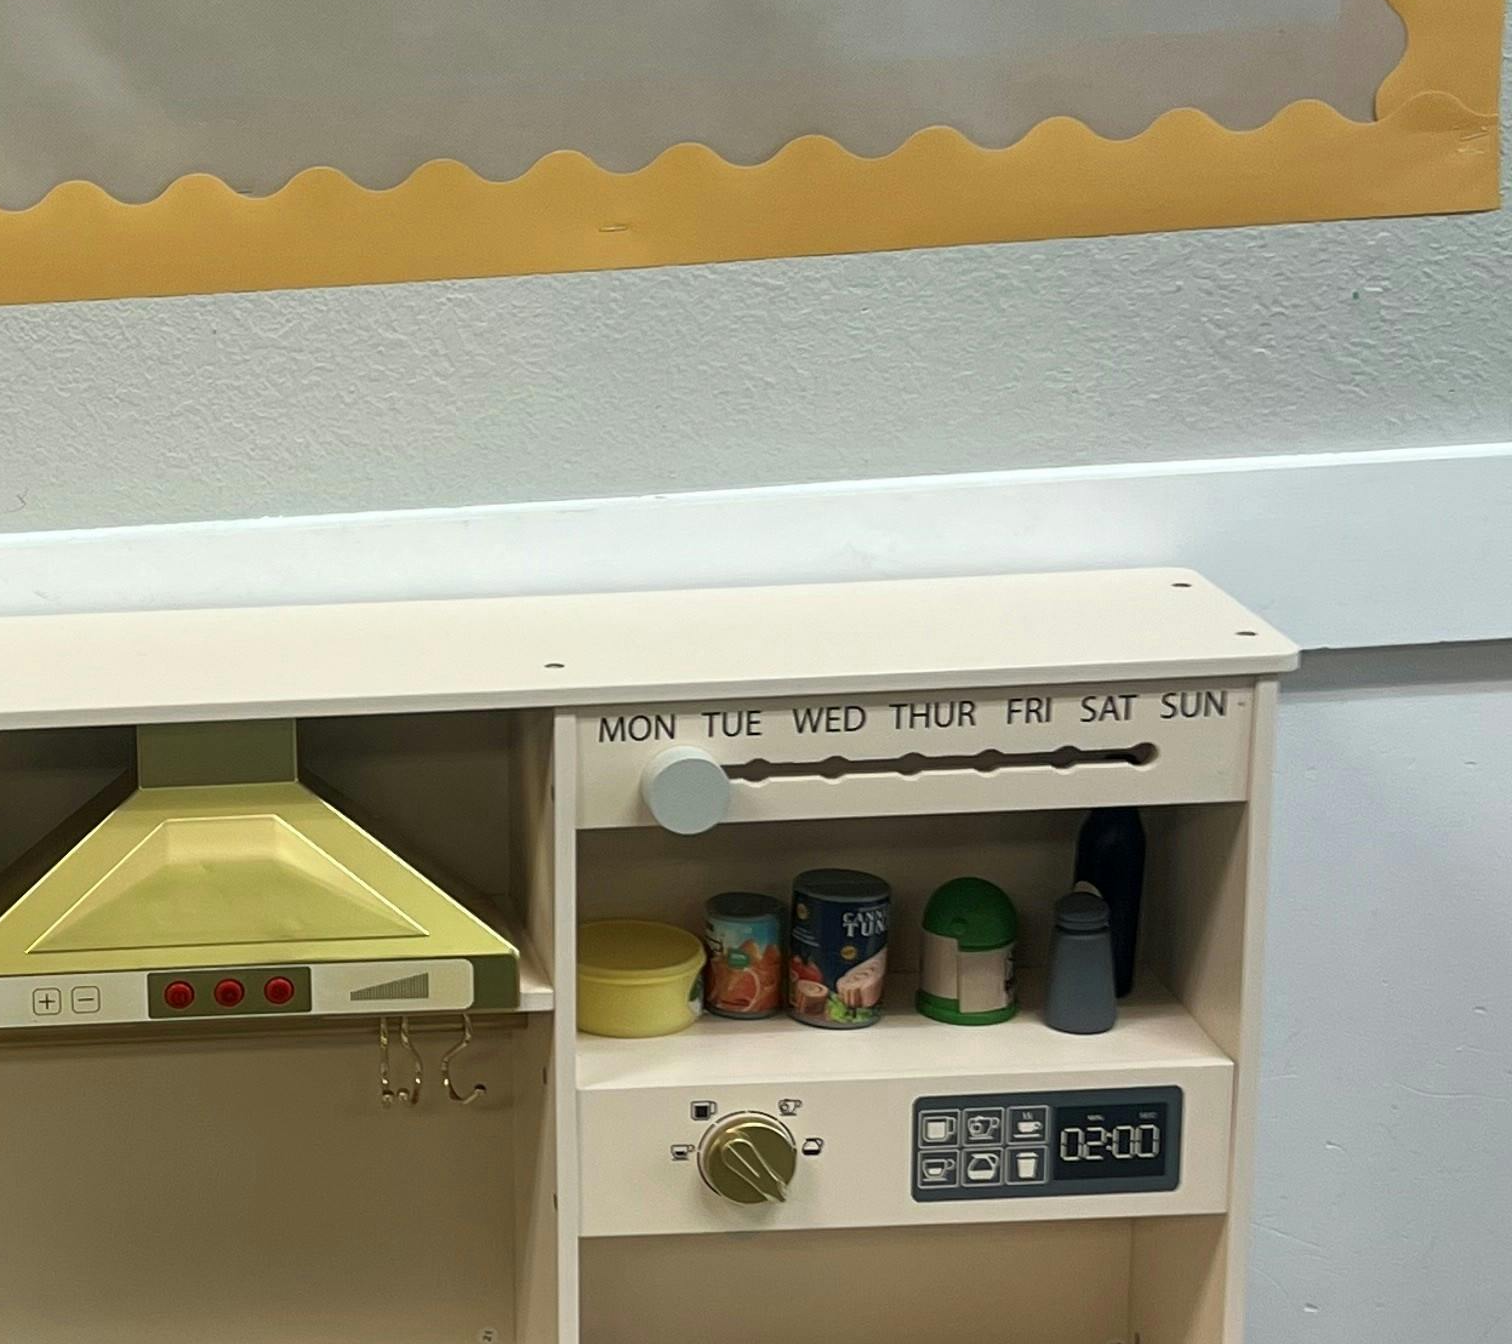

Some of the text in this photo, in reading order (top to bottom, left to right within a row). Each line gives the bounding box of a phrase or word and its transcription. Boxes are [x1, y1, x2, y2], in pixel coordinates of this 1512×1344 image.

[598, 689, 1227, 744] MON TUE WED THUR FRI SAT SUN
[1060, 1124, 1160, 1161] 02:00
